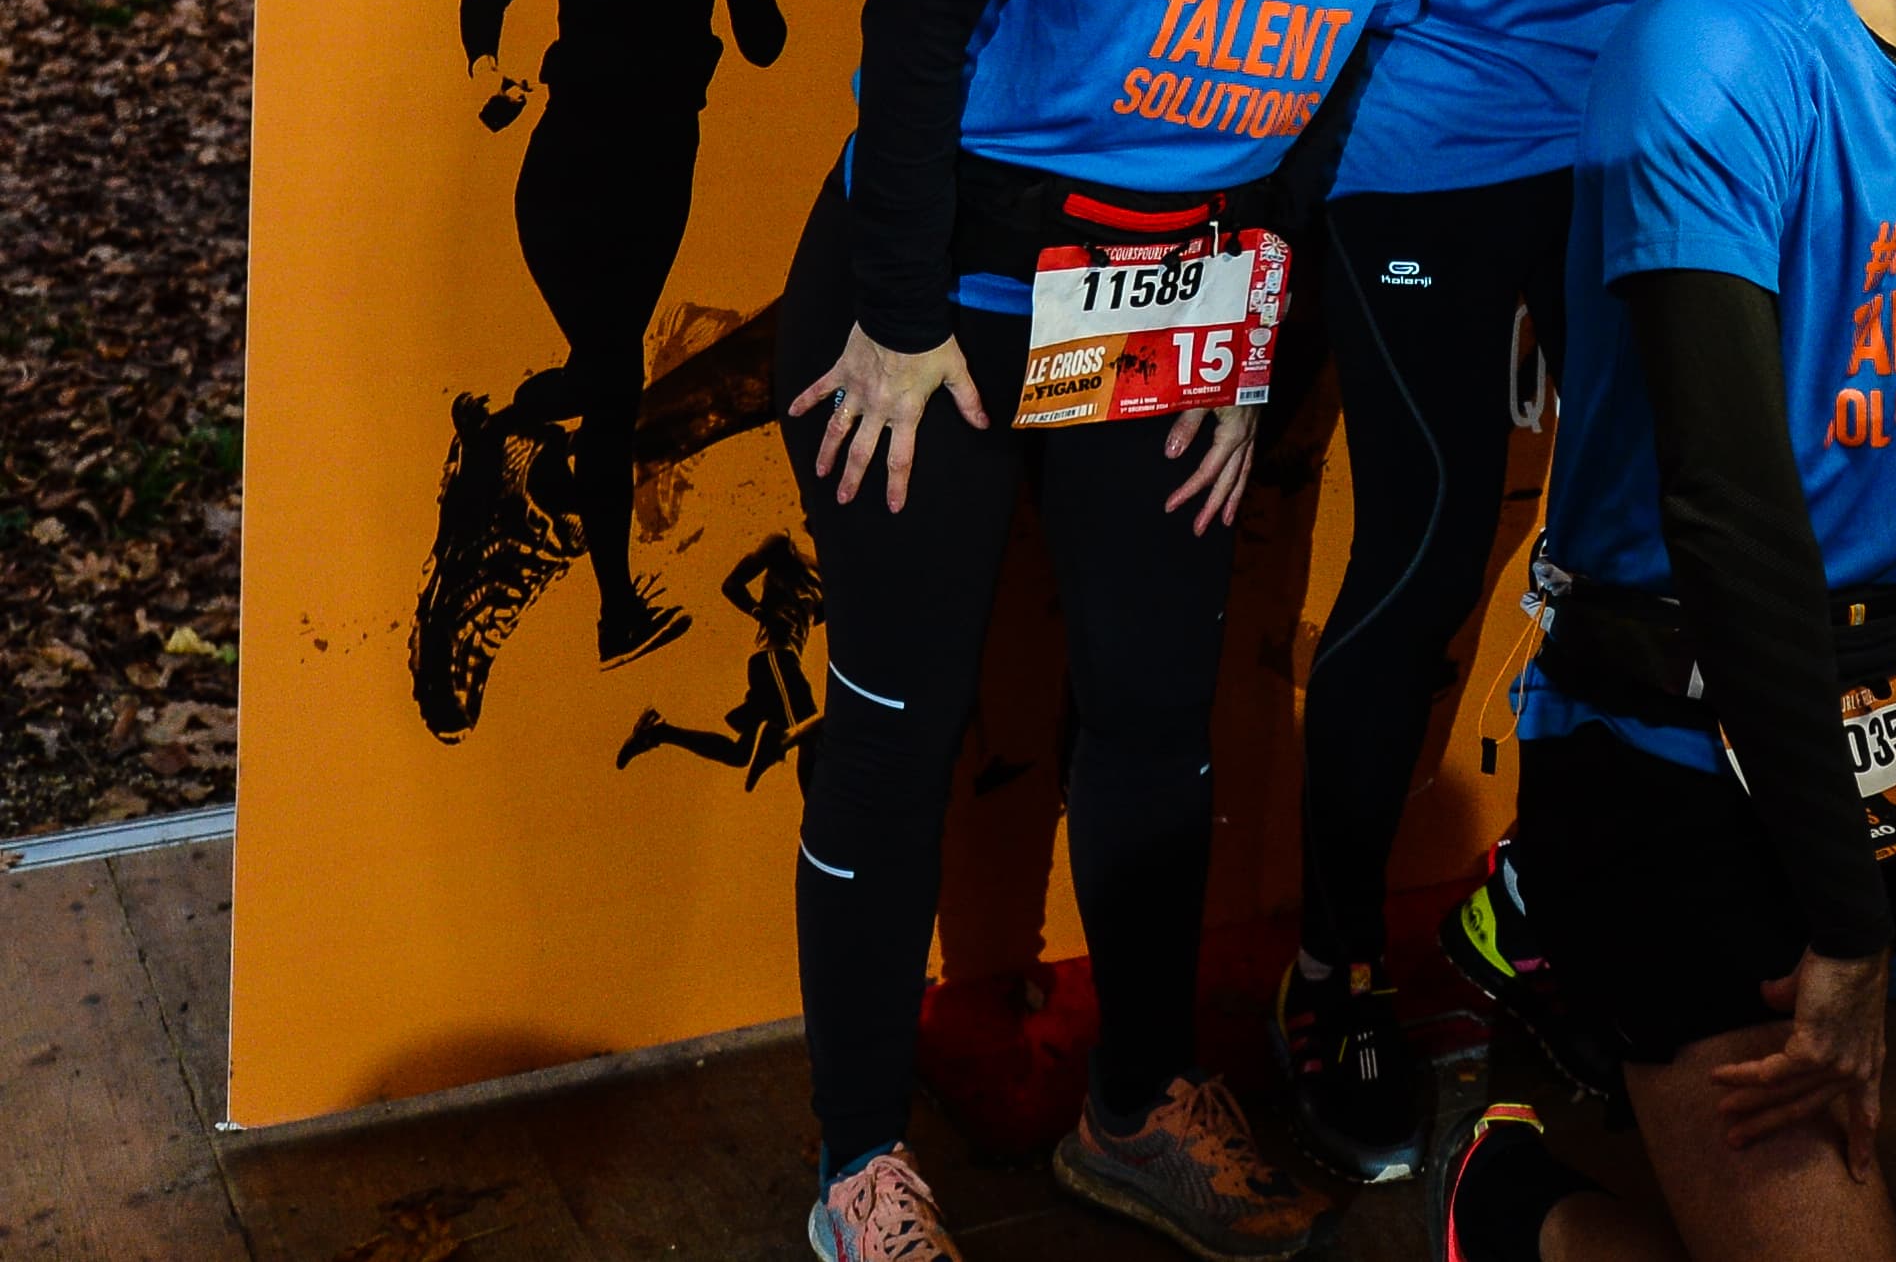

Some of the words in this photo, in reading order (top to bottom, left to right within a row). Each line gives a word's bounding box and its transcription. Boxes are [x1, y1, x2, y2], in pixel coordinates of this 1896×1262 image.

[1112, 66, 1322, 139] SOLUTIONS
[1082, 262, 1204, 312] 11589
[1026, 355, 1050, 385] LE
[1050, 345, 1106, 380] CROSS
[1173, 329, 1234, 386] 15
[1248, 347, 1267, 360] 2€
[1034, 375, 1102, 400] FIGARO
